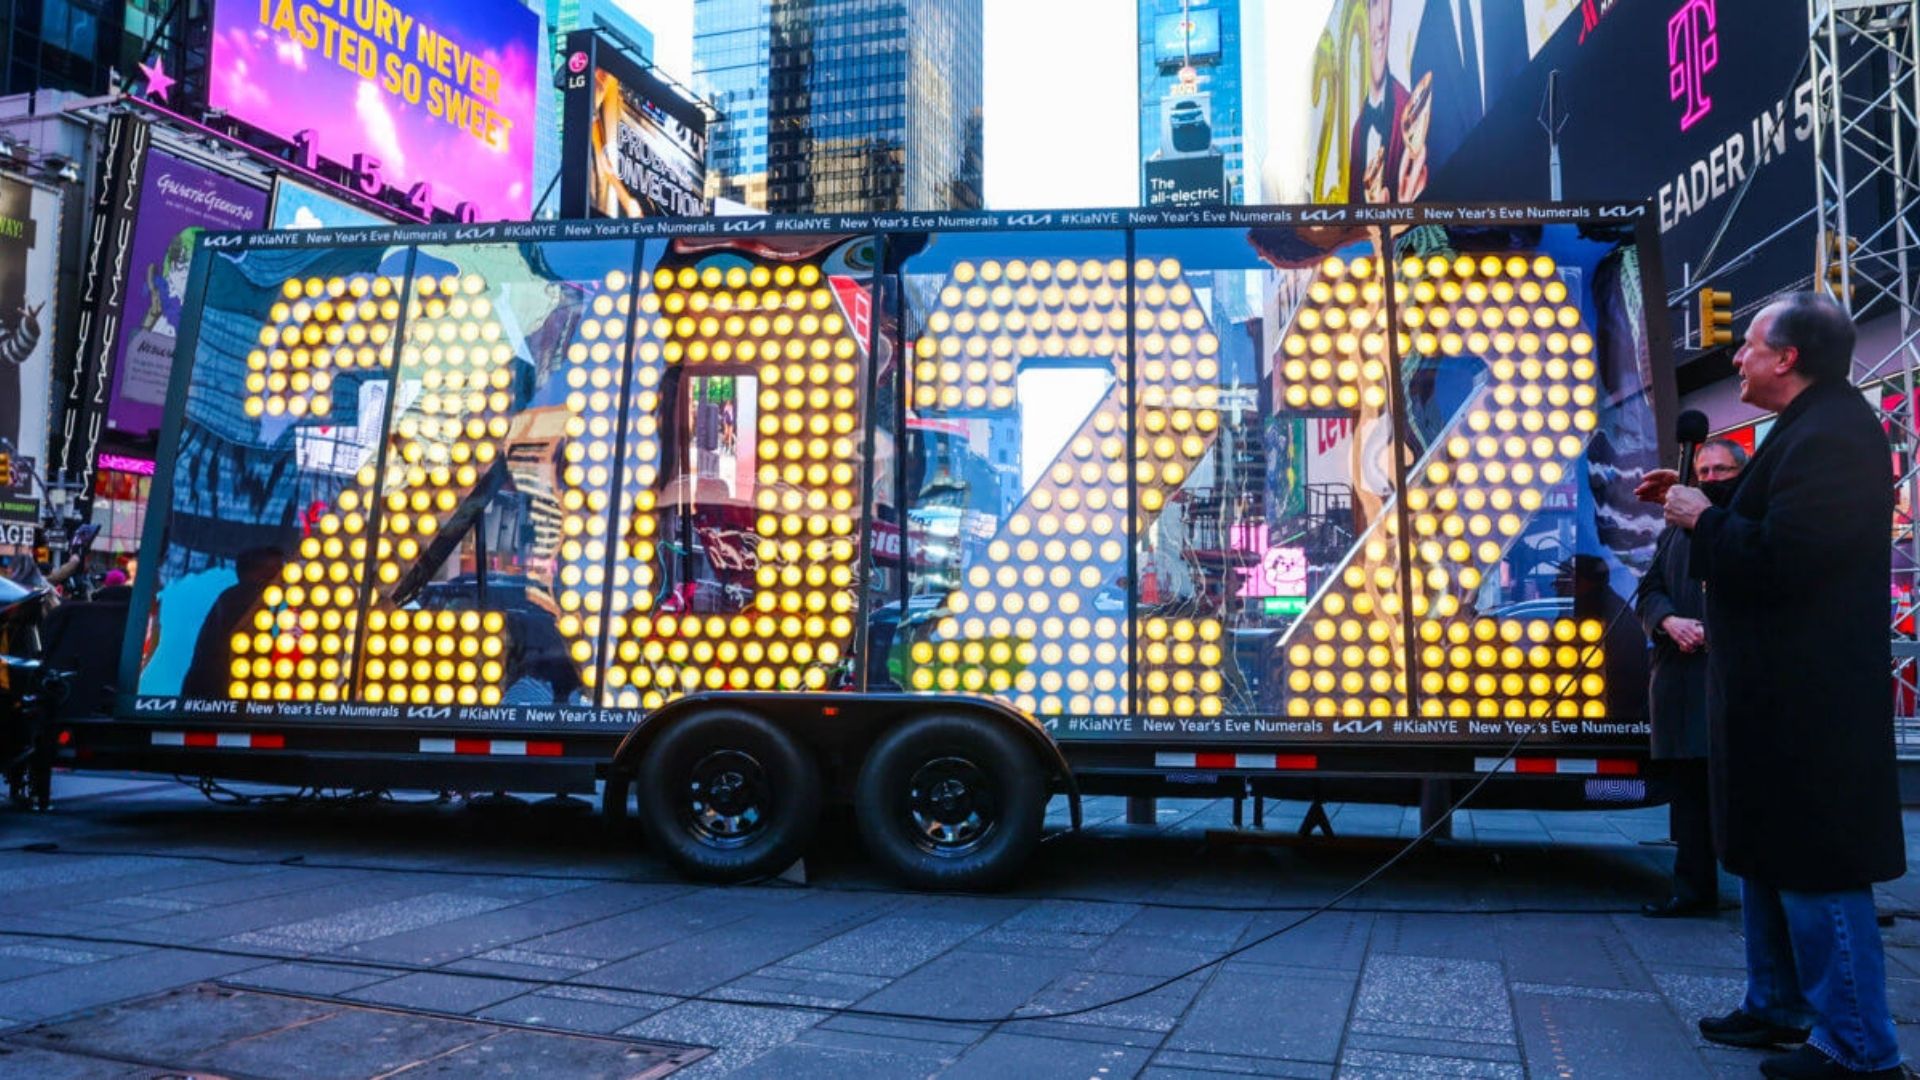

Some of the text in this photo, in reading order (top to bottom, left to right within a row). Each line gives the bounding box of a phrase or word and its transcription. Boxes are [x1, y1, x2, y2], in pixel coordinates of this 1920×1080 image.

[259, 0, 514, 154] TASTED SO SWEET
[418, 23, 500, 104] NEVER
[568, 75, 586, 88] LG
[617, 150, 704, 217] ONVECTION
[1151, 177, 1175, 190] The
[1658, 132, 1746, 235] EADER
[1752, 99, 1787, 166] IN
[1151, 187, 1220, 205] all-electric
[249, 233, 299, 245] #KiaNYE
[307, 232, 332, 243] New
[335, 231, 367, 243] Year's
[370, 231, 390, 242] Eve
[393, 229, 448, 241] Numerals
[504, 225, 557, 237] #KiaNYE
[565, 224, 592, 235] New
[595, 223, 629, 235] Year's
[632, 222, 654, 233] Eve
[657, 221, 715, 233] Numerals
[775, 218, 831, 230] #KiaNYE
[840, 218, 869, 229] New
[872, 217, 909, 229] Year's
[912, 216, 936, 228] Eve
[938, 215, 998, 227] Numerals
[1061, 212, 1119, 224] #KiaNYE
[1129, 212, 1158, 223] New
[1161, 211, 1199, 223] Year's
[1203, 210, 1226, 222] Eve
[1230, 210, 1292, 222] Numerals
[1355, 208, 1414, 220] #KiaNYE
[1424, 208, 1454, 220] New
[1457, 207, 1496, 219] Year's
[1500, 207, 1524, 219] Eve
[1527, 206, 1590, 218] Numerals
[60, 408, 77, 470] AC
[228, 253, 1608, 719] 2022
[184, 700, 238, 714] #KiaNYE
[246, 701, 275, 714] New
[277, 702, 311, 716] Year's
[314, 704, 336, 716] Eve
[338, 704, 400, 718] Numerals
[459, 707, 517, 721] #KiaNYE
[526, 709, 556, 722] New
[559, 709, 597, 723] Year's
[600, 710, 624, 723] Eve
[1069, 718, 1132, 731] #KiaNYE
[1143, 719, 1175, 732] New
[1179, 719, 1221, 732] Year's
[1225, 719, 1251, 732] Eve
[1255, 719, 1323, 733] Numerals
[1393, 720, 1459, 734] #KiaNYE
[1469, 721, 1500, 734] New
[1502, 721, 1548, 734] Yea's
[1551, 721, 1578, 734] Eve
[1582, 721, 1650, 735] Numerals
